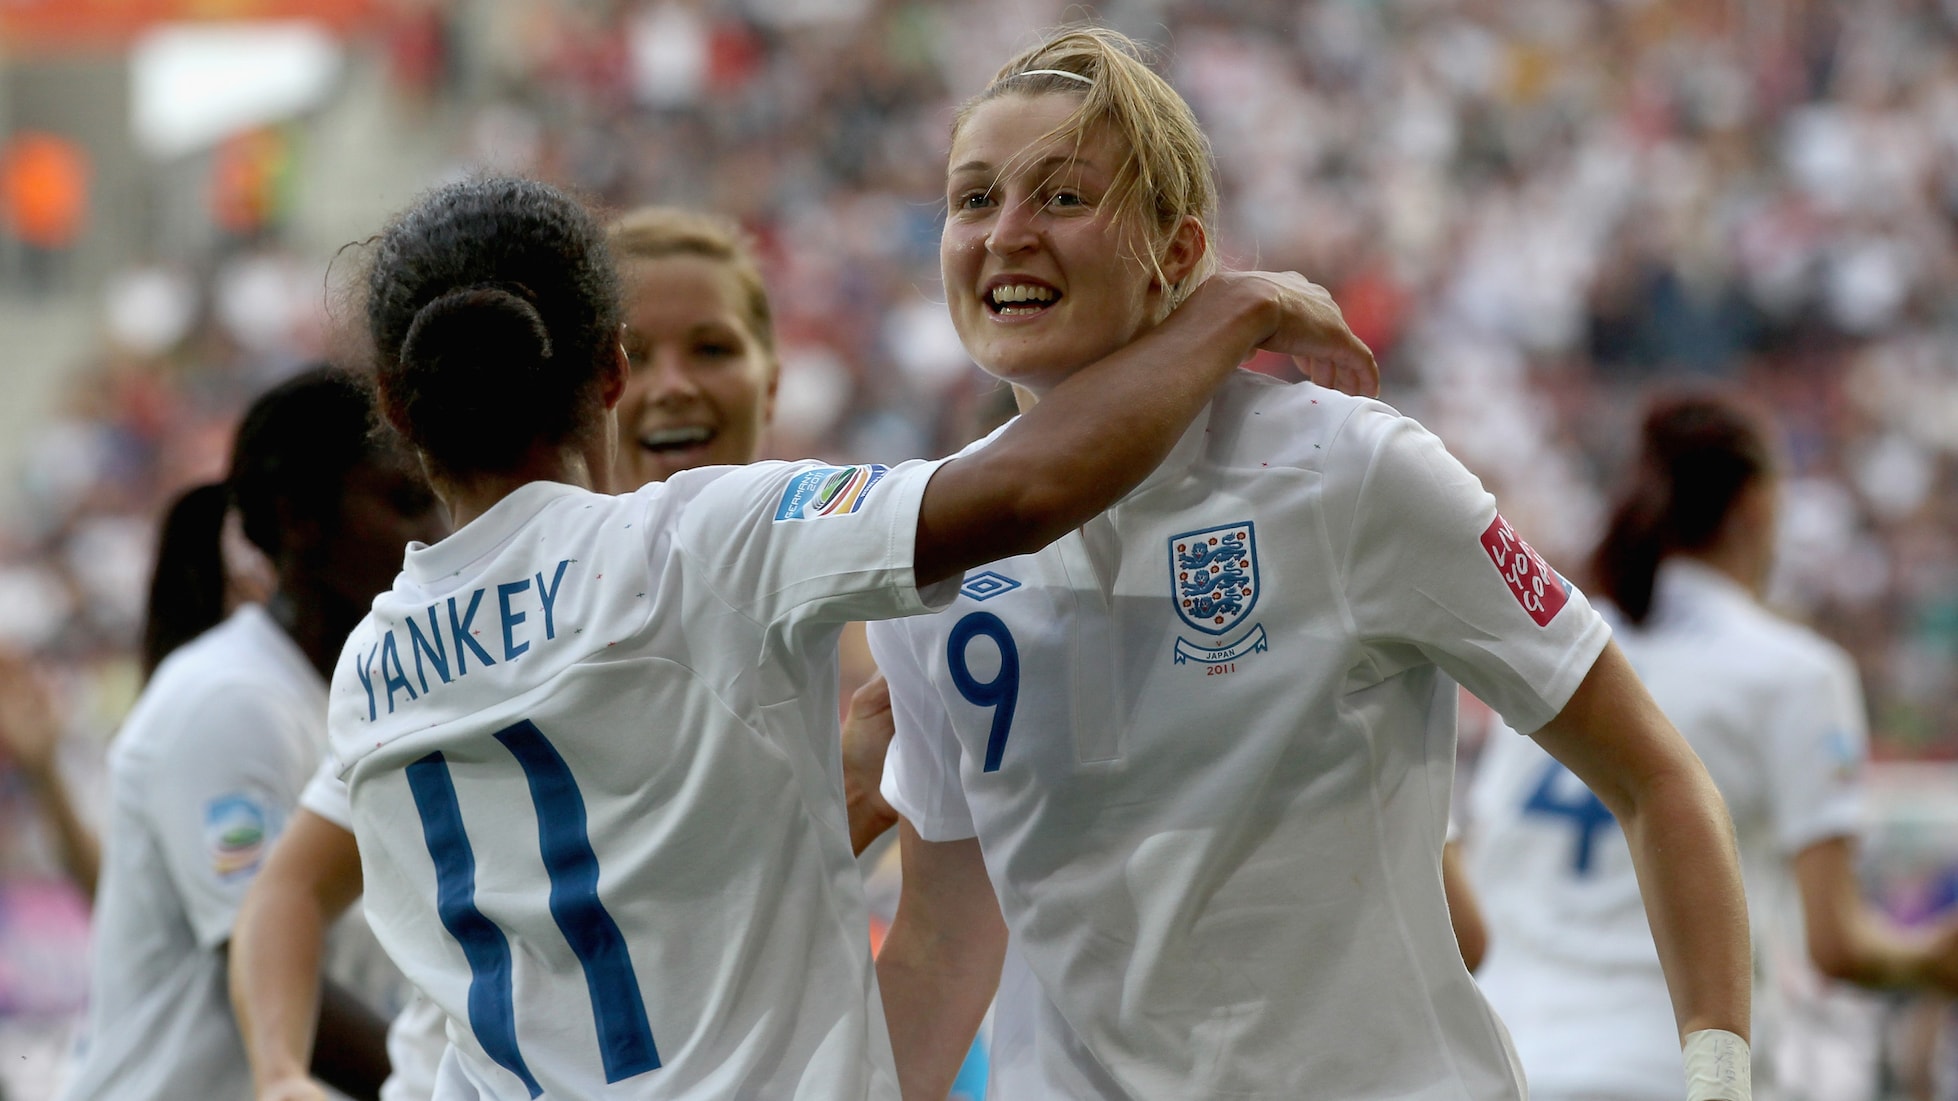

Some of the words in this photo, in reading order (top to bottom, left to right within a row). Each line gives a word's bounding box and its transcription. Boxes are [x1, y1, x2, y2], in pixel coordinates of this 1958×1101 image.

[784, 470, 815, 520] GERMANY
[806, 471, 825, 492] 2011
[356, 559, 570, 723] YANKEY
[1206, 649, 1236, 660] JAPAN
[946, 611, 1020, 773] 9
[1207, 663, 1235, 676] 2011
[404, 718, 662, 1100] 11
